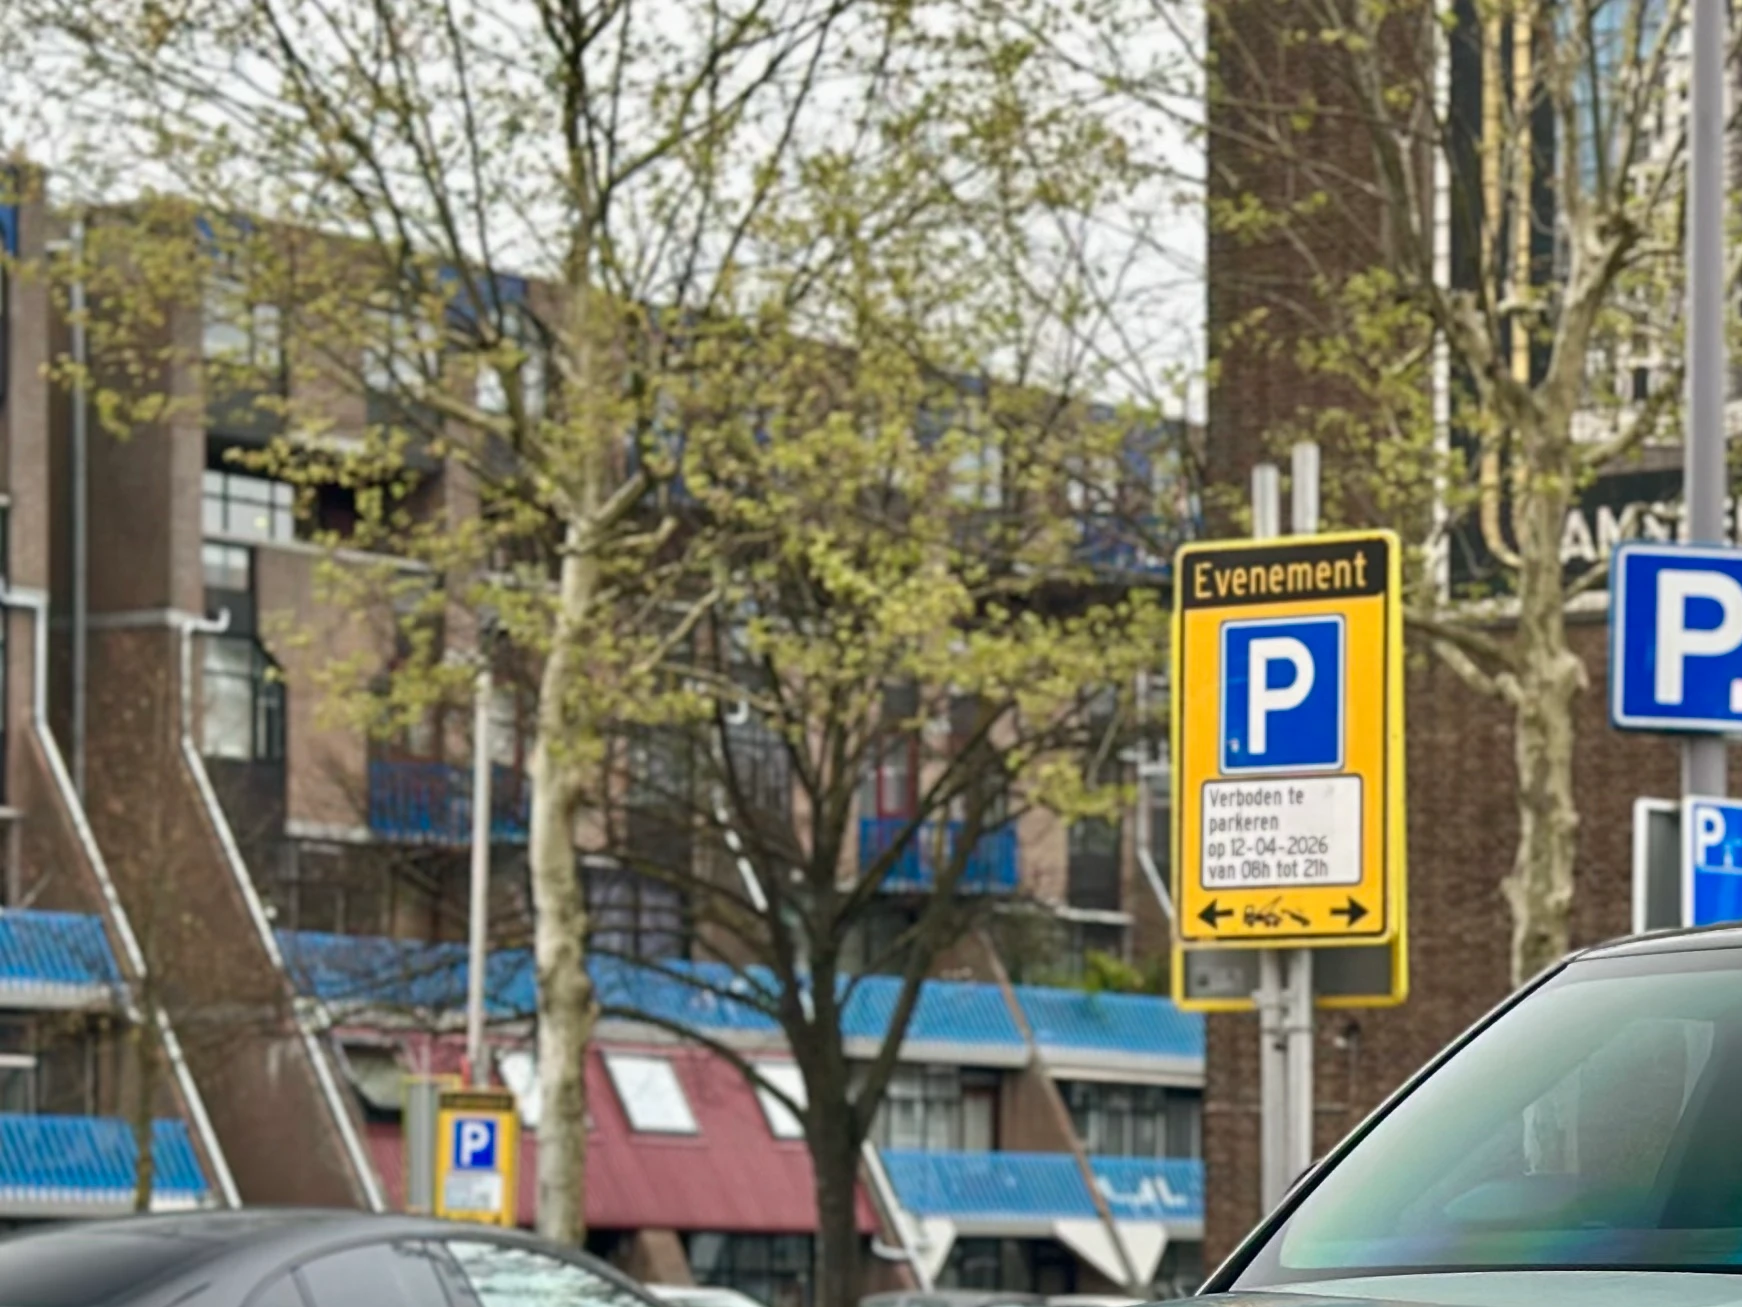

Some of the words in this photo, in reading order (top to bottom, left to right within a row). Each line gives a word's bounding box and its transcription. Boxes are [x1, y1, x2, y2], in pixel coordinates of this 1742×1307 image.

[1195, 551, 1367, 599] Evenement
[1248, 636, 1315, 755] P
[1209, 787, 1282, 807] Verboden
[1288, 787, 1304, 805] te
[1209, 813, 1280, 835] parkeren
[1696, 806, 1727, 867] P
[1208, 841, 1226, 859] op
[1230, 836, 1329, 857] 12-04-2026
[1208, 863, 1236, 880] van
[1276, 859, 1298, 878] tot
[1303, 858, 1329, 877] 21h
[461, 1121, 490, 1168] P
